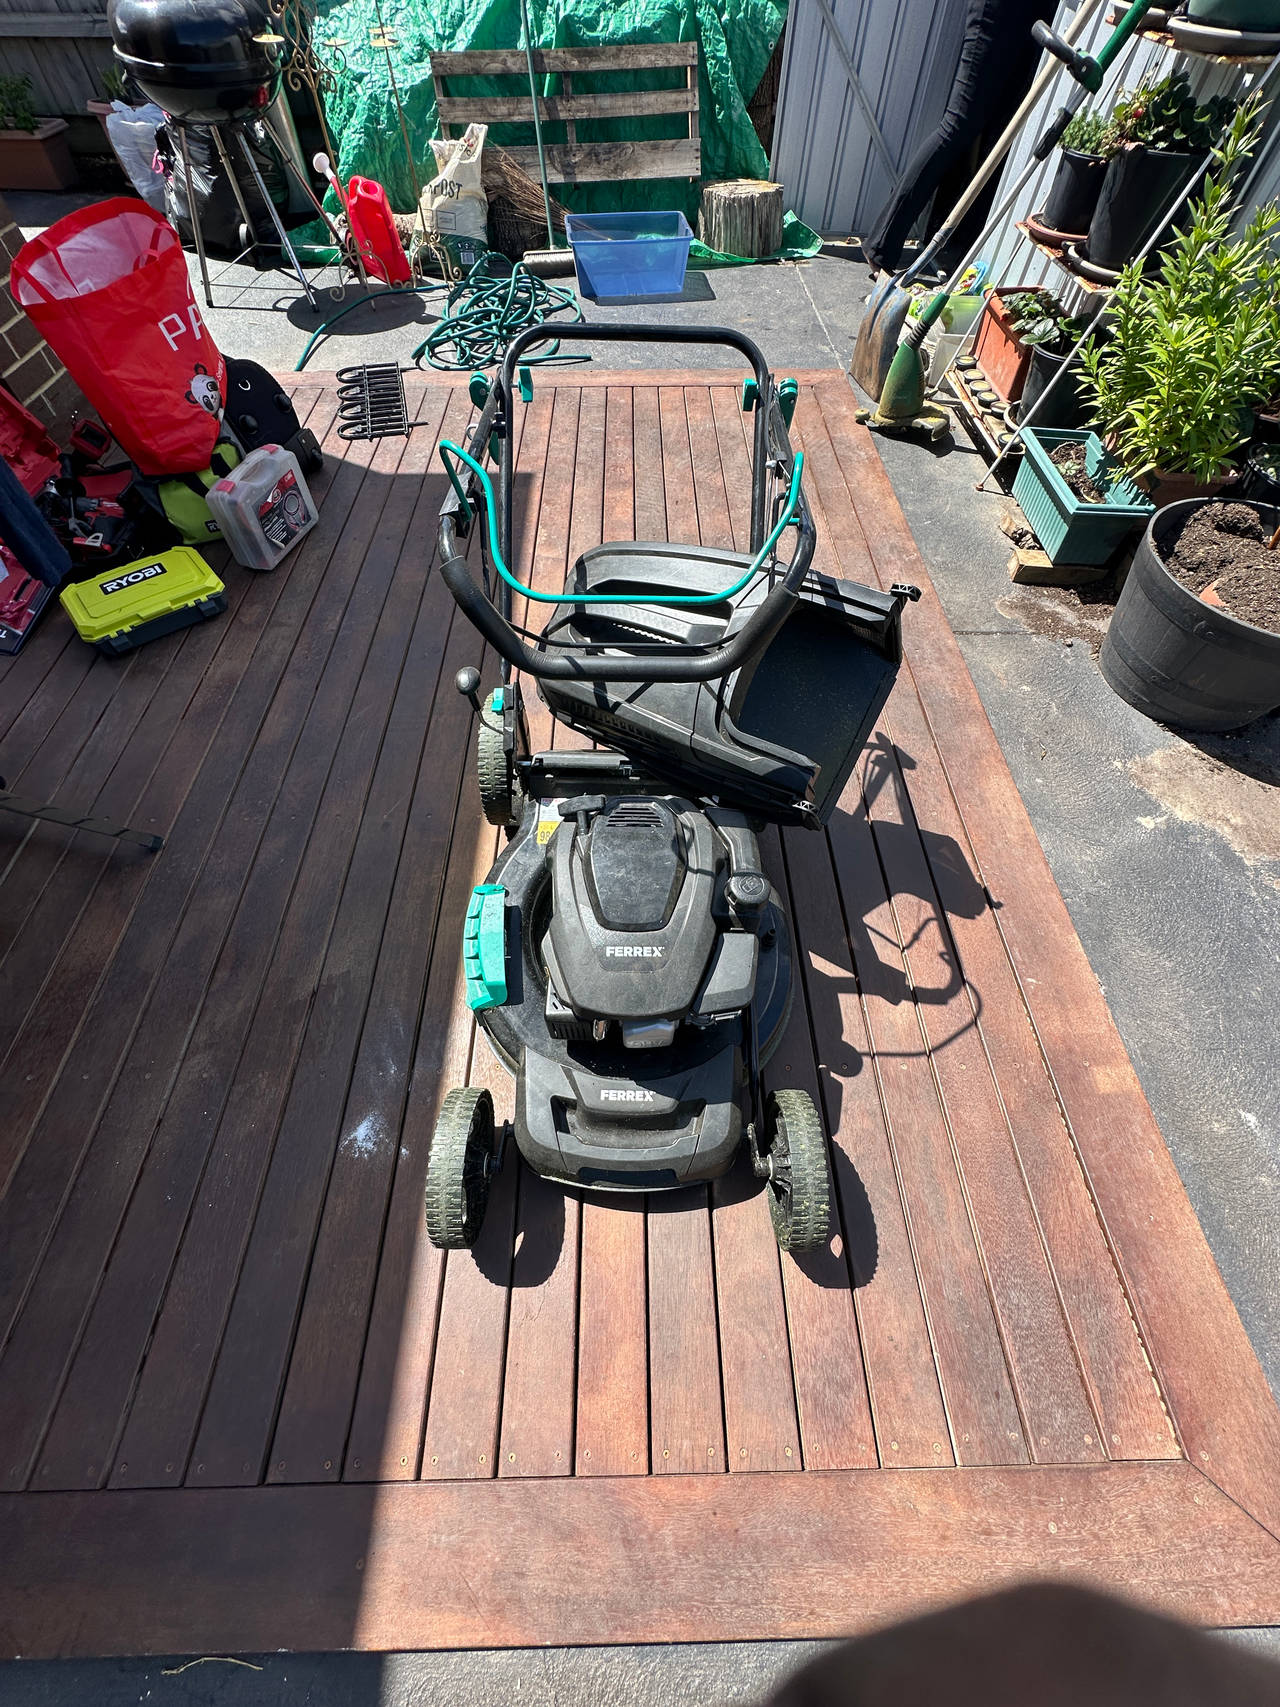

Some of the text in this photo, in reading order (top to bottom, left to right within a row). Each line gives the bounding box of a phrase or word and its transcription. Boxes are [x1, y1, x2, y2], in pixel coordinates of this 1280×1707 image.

[103, 564, 163, 593] RYOBI
[605, 945, 664, 958] FERREX
[600, 1089, 655, 1102] FERREX
